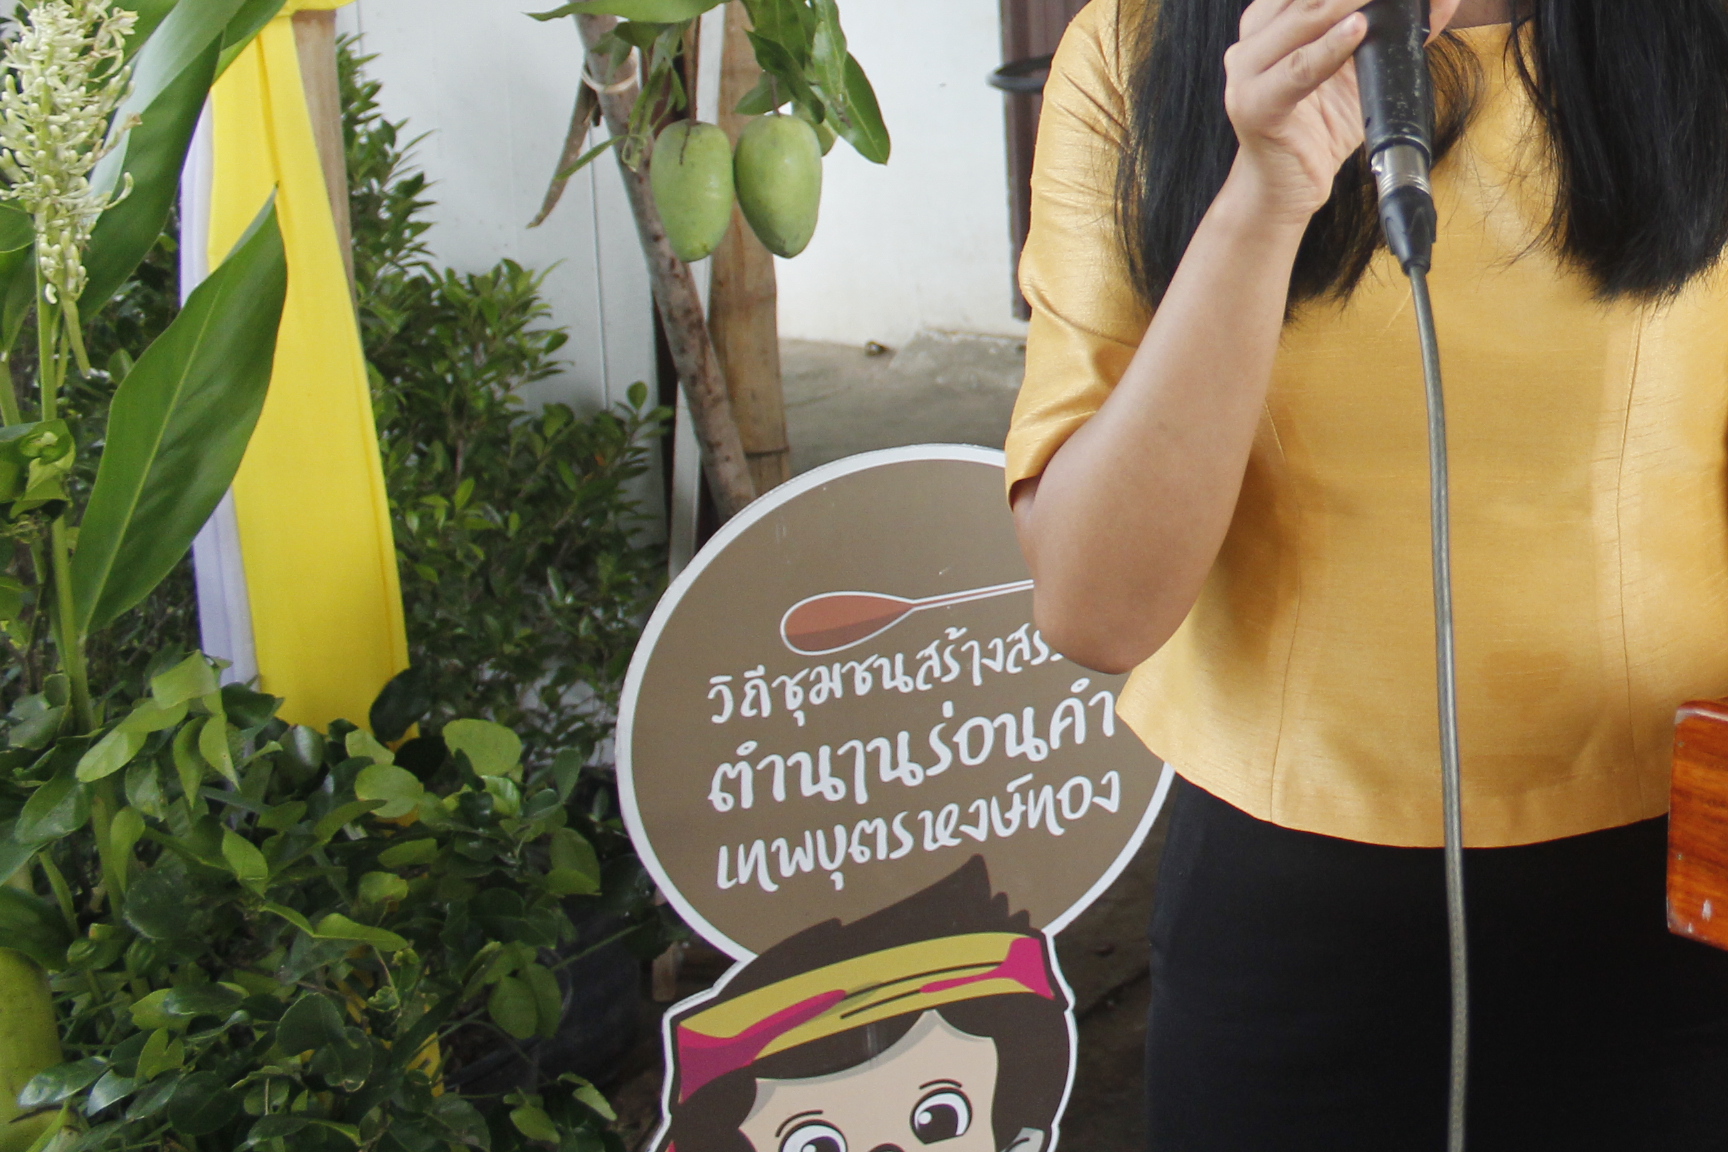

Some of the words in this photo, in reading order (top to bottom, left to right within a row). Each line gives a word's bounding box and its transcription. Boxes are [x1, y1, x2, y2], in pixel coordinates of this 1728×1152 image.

[707, 622, 1064, 727] วิถีชุมชนสร้างสร
[708, 677, 1115, 812] ตำนานร่อนคำ
